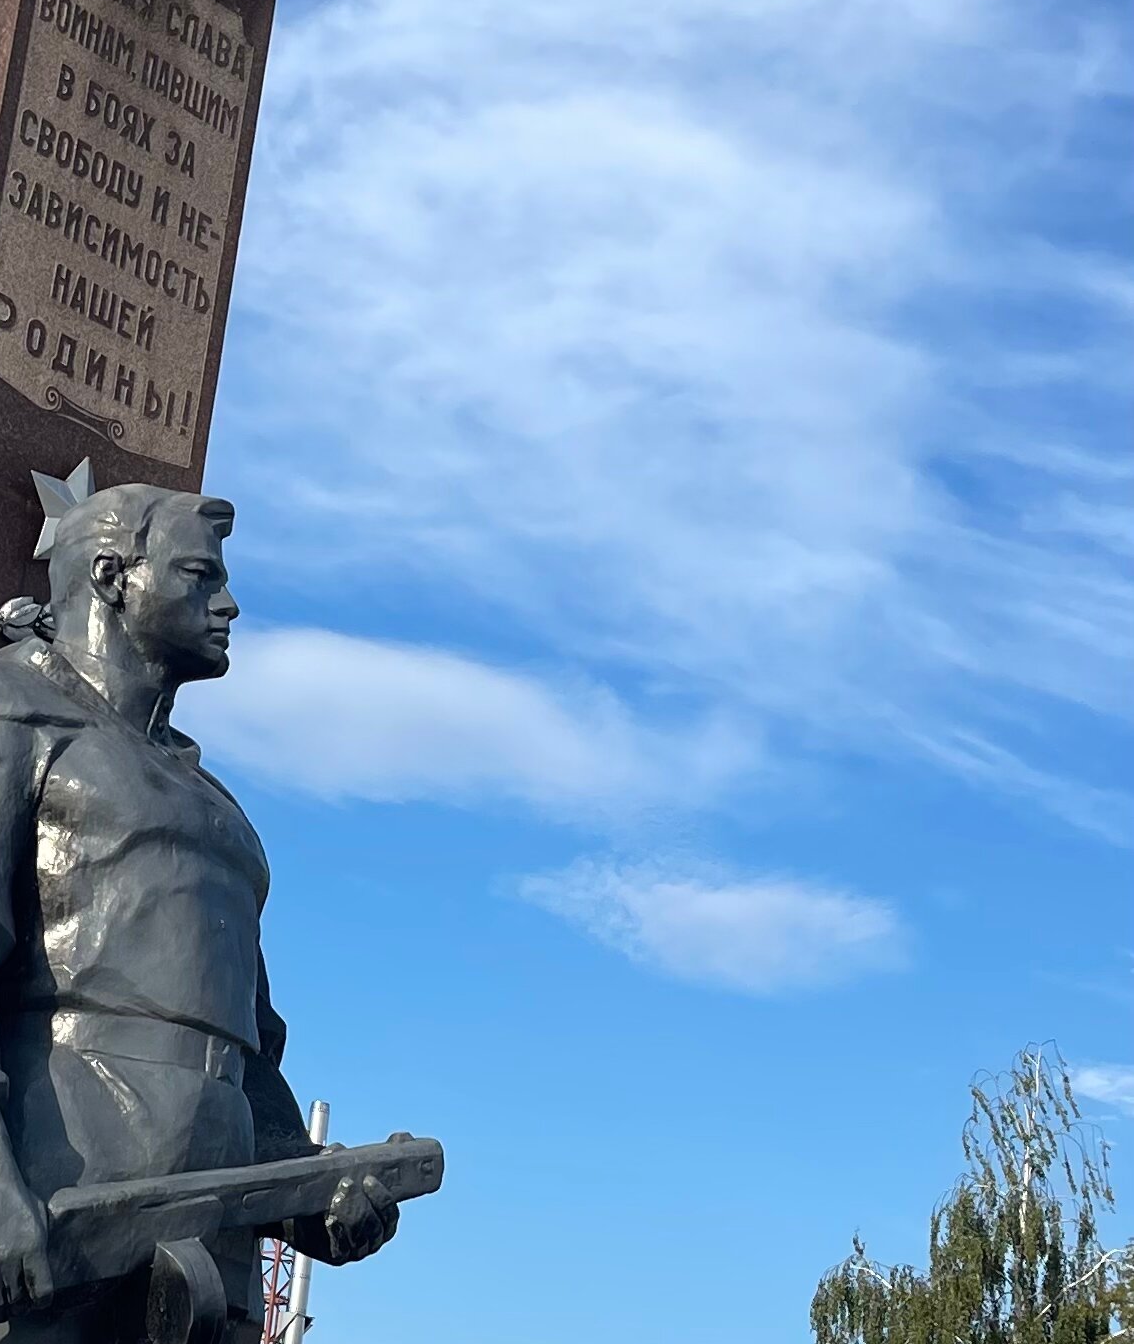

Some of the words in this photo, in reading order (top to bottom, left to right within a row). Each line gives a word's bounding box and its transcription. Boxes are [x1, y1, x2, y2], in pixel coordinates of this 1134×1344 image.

[167, 2, 245, 82] СЛАВА
[56, 63, 76, 101] В
[84, 79, 156, 153] БОЯХ
[165, 131, 196, 179] ЗА
[141, 49, 240, 141] ПАВШИМ
[20, 108, 143, 208] СВОБОДУ
[151, 185, 171, 227] И
[177, 201, 220, 253] НЕ-
[8, 170, 210, 315] ЗАВИСИМОСТЬ
[51, 263, 155, 352] НАШЕЙ
